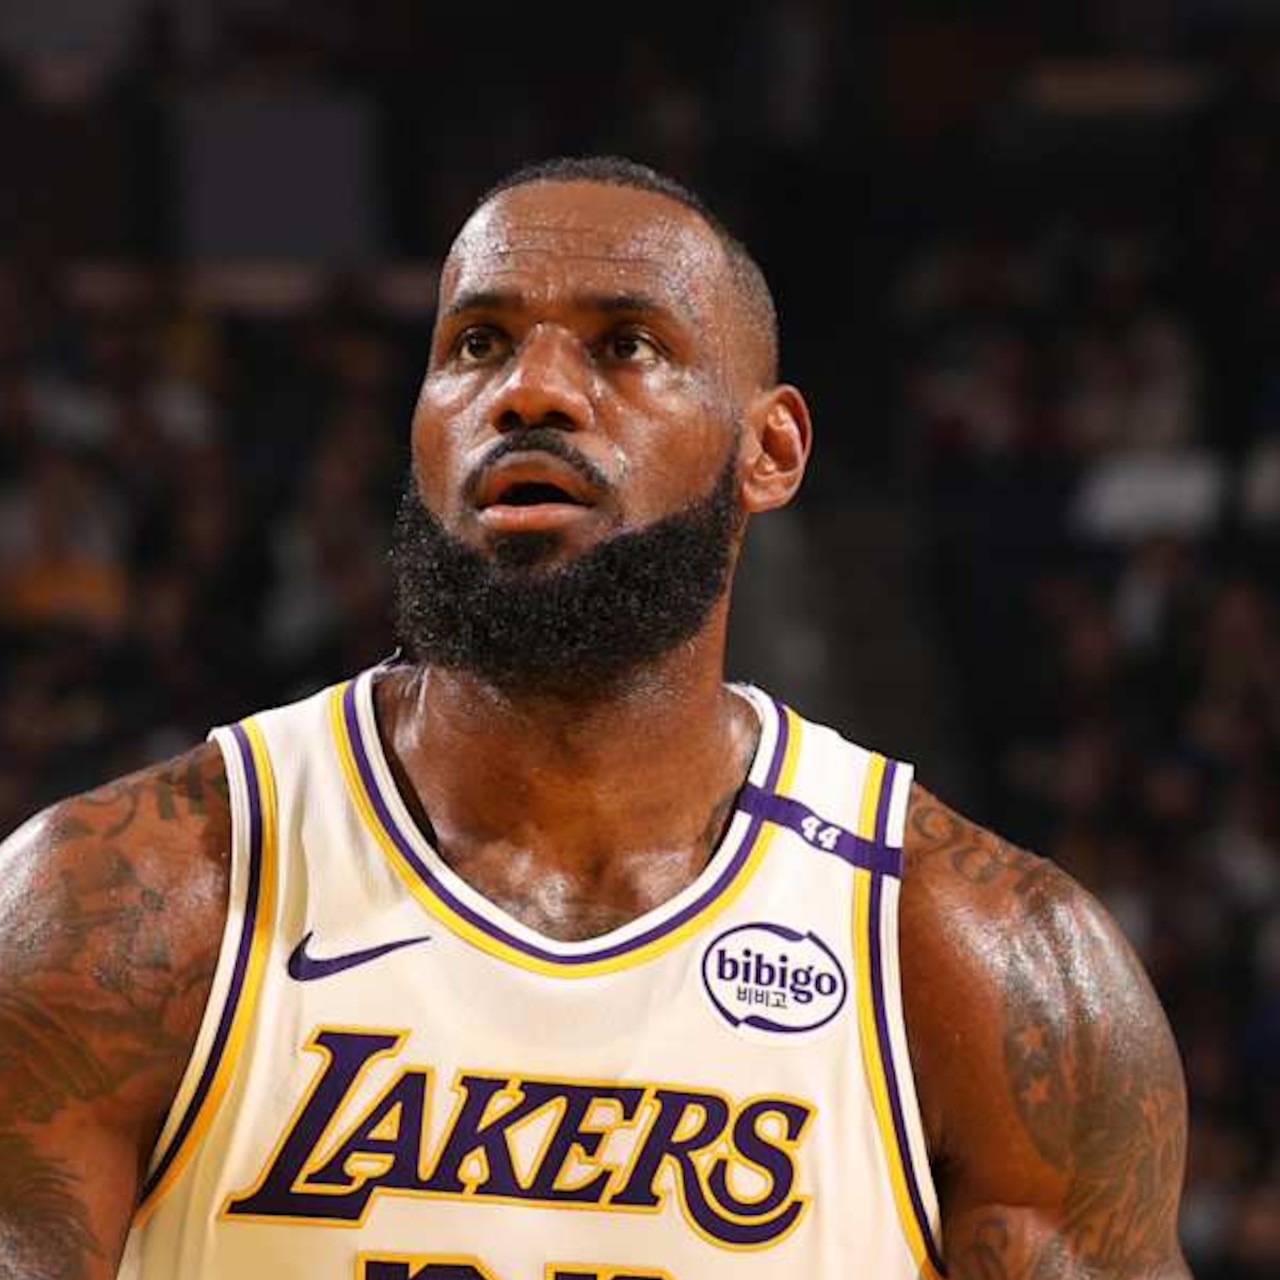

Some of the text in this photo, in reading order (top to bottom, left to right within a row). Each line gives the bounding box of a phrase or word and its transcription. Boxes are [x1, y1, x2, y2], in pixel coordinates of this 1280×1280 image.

[801, 816, 842, 850] 44
[717, 948, 838, 1004] bibigo
[737, 986, 789, 1009] 비비고
[221, 1025, 816, 1249] LAKERS
